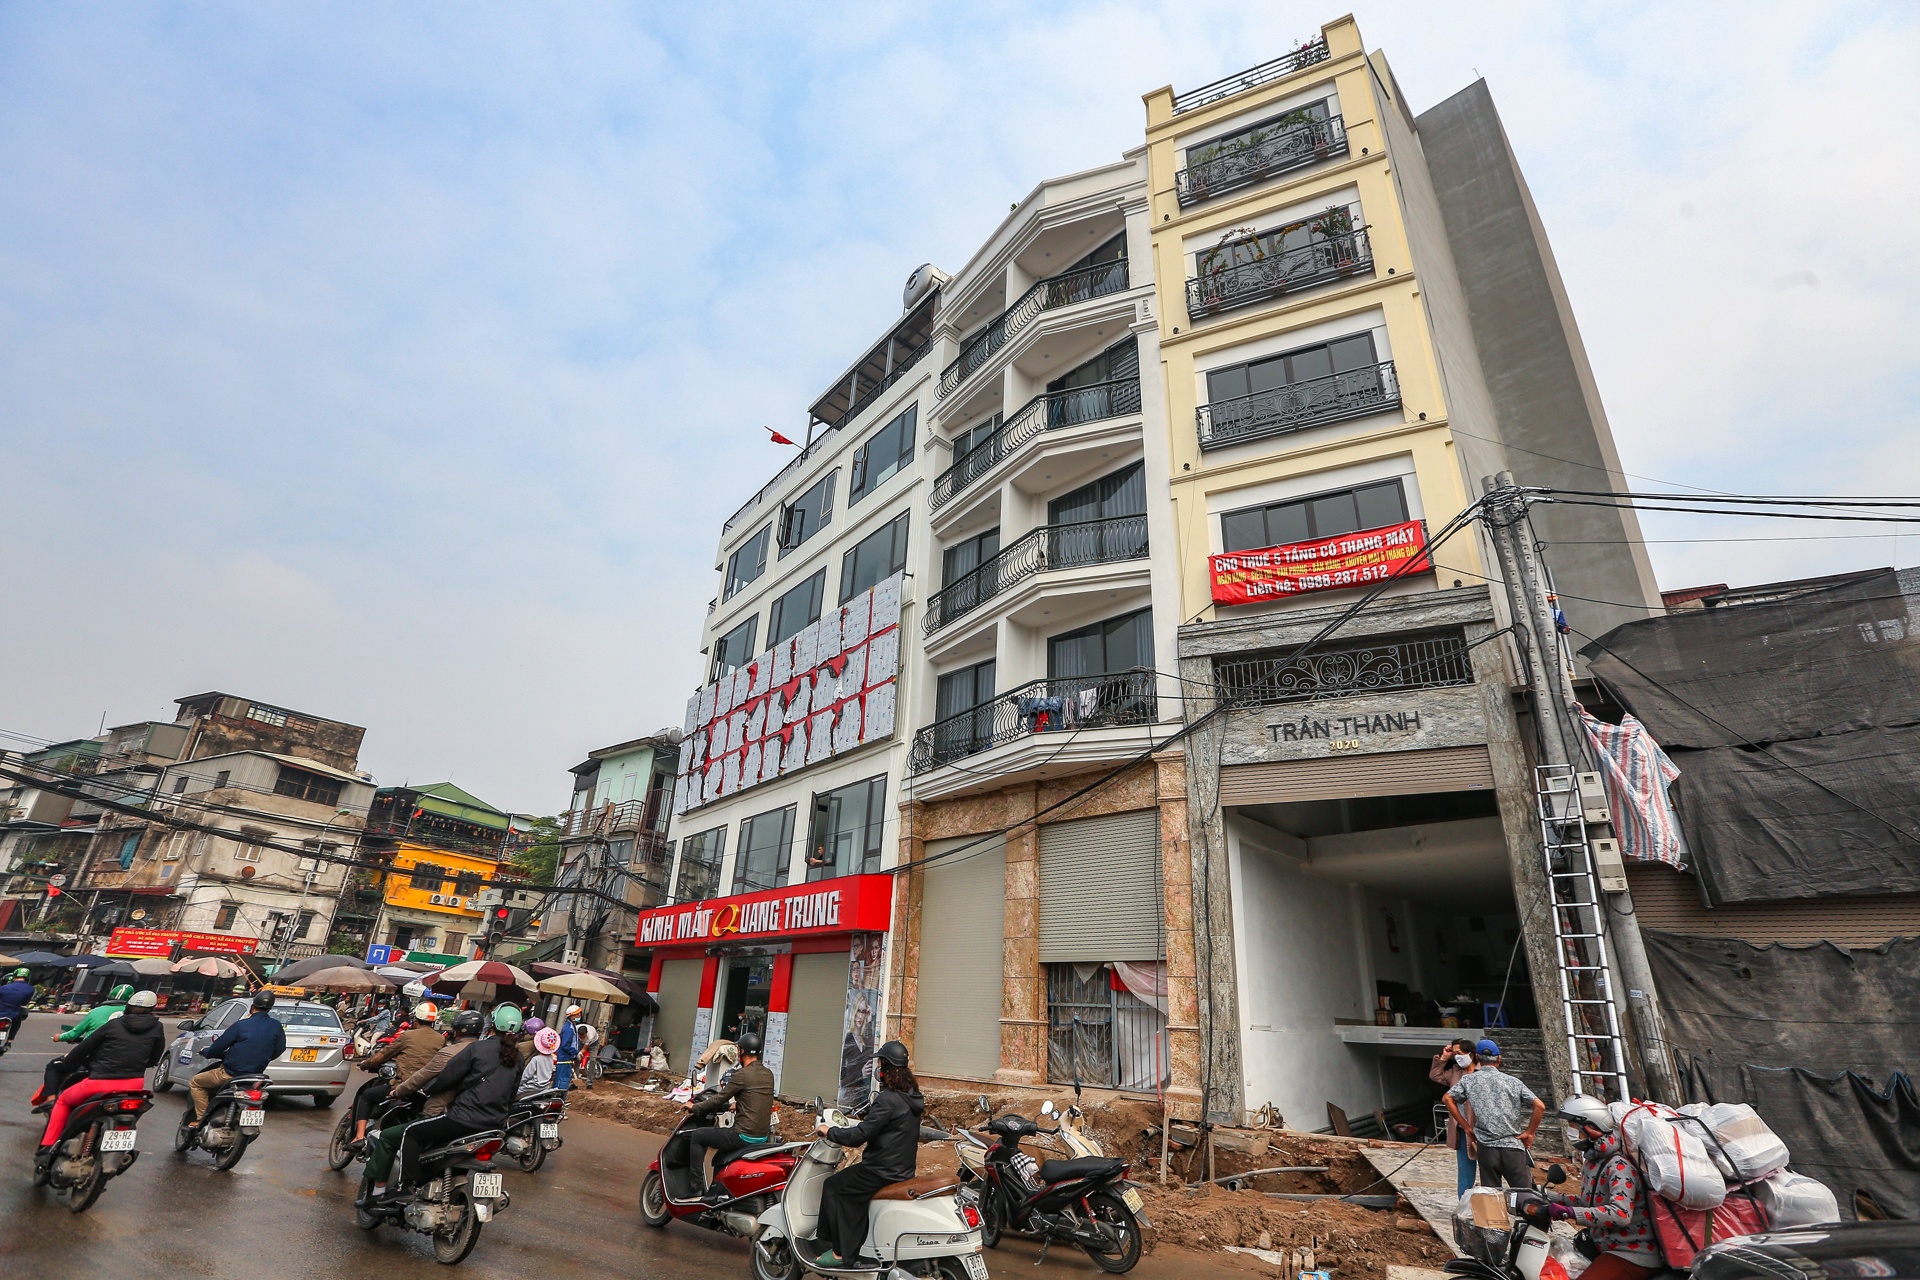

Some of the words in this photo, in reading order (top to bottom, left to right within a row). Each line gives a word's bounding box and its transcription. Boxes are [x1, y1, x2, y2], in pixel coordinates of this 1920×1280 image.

[1215, 558, 1238, 572] CHO
[1240, 552, 1270, 568] THUÊ
[1274, 553, 1281, 564] 5
[1284, 546, 1316, 563] TẦNG
[1320, 542, 1337, 557] CÓ
[1340, 536, 1383, 554] THANG
[1345, 552, 1368, 568] KHUYẾN
[1386, 547, 1406, 560] THÁNG
[1246, 582, 1272, 596] Liên
[1298, 564, 1388, 590] 0988.287.512
[1330, 740, 1359, 750] 2020
[640, 912, 675, 942] KÍNH
[676, 902, 713, 939] MẮT
[712, 900, 781, 937] QUANG
[784, 890, 841, 930] TRUNG
[103, 1141, 132, 1150] 249.96
[478, 1175, 498, 1185] 29-L1
[474, 1186, 499, 1195] 076.11
[916, 1236, 941, 1246] Vespa
